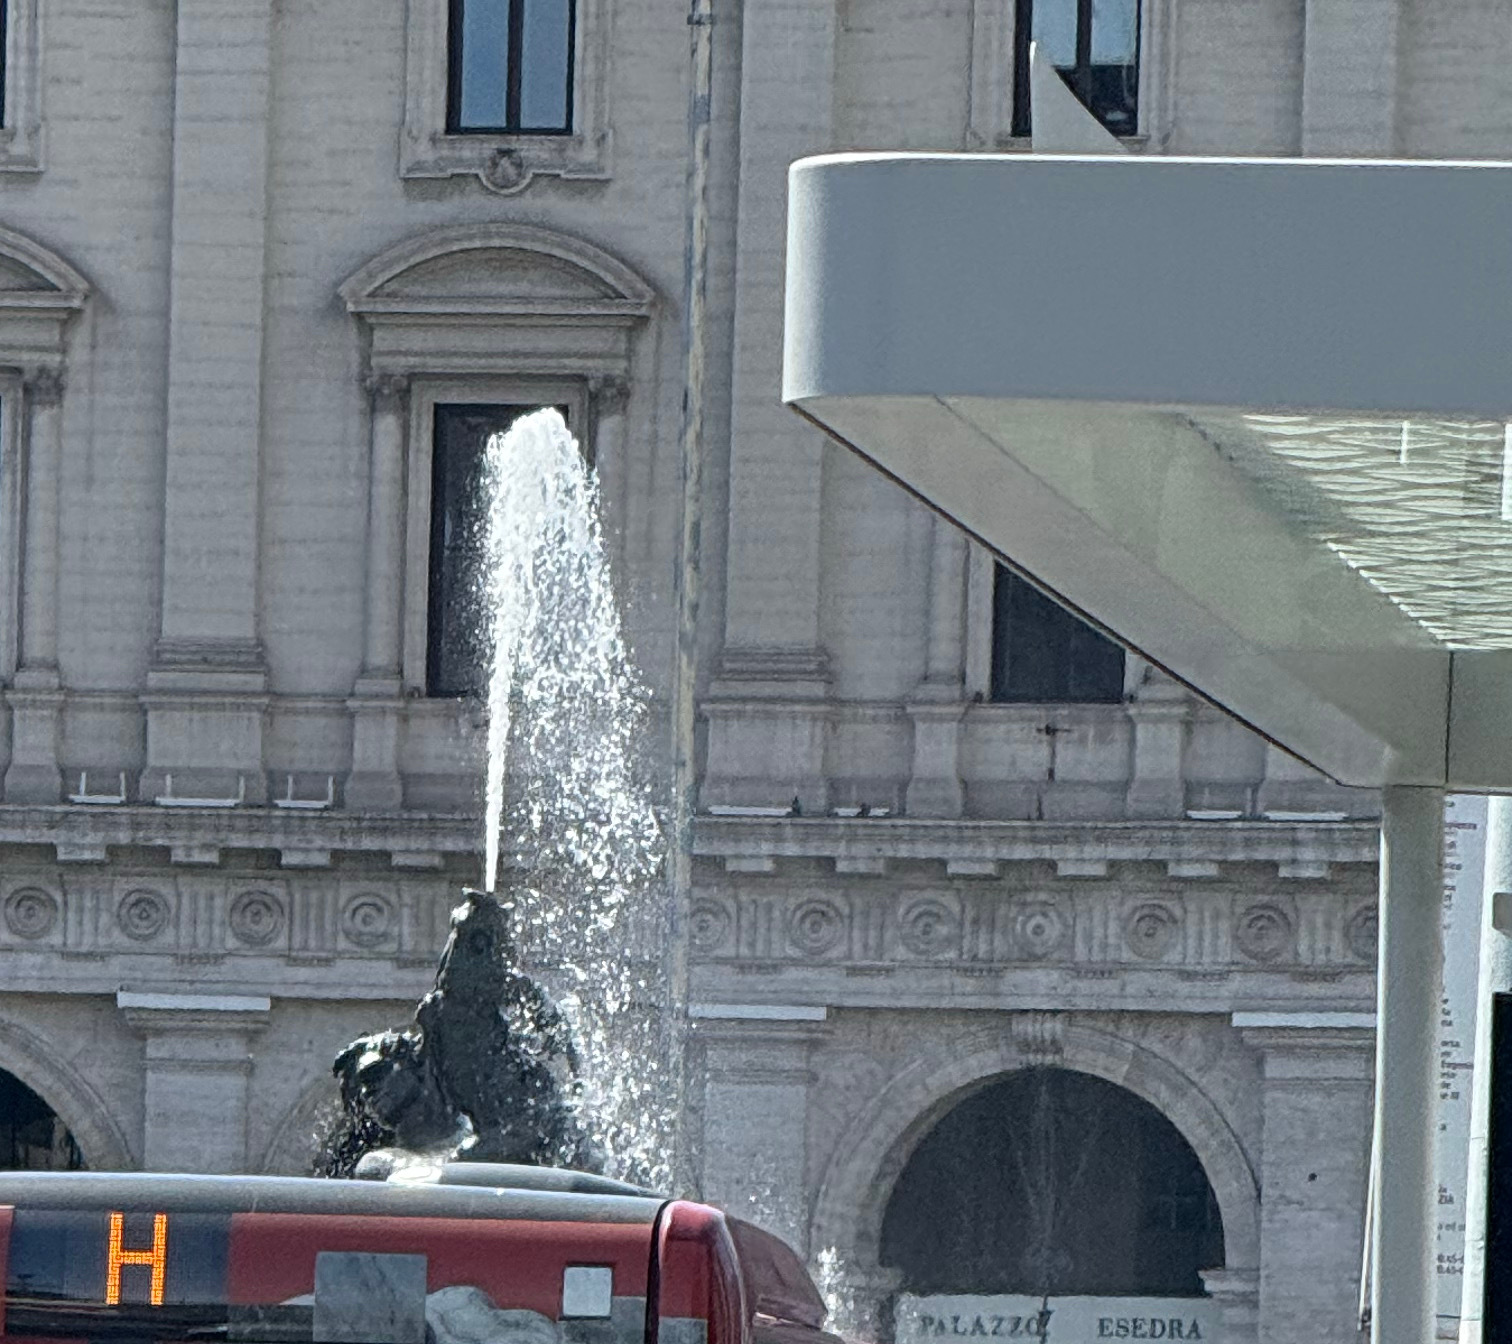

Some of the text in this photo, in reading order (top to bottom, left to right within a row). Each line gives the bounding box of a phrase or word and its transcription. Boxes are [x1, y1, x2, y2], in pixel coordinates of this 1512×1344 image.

[106, 1212, 167, 1305] H
[920, 1313, 1203, 1340] PALAZZO ESEDRA
